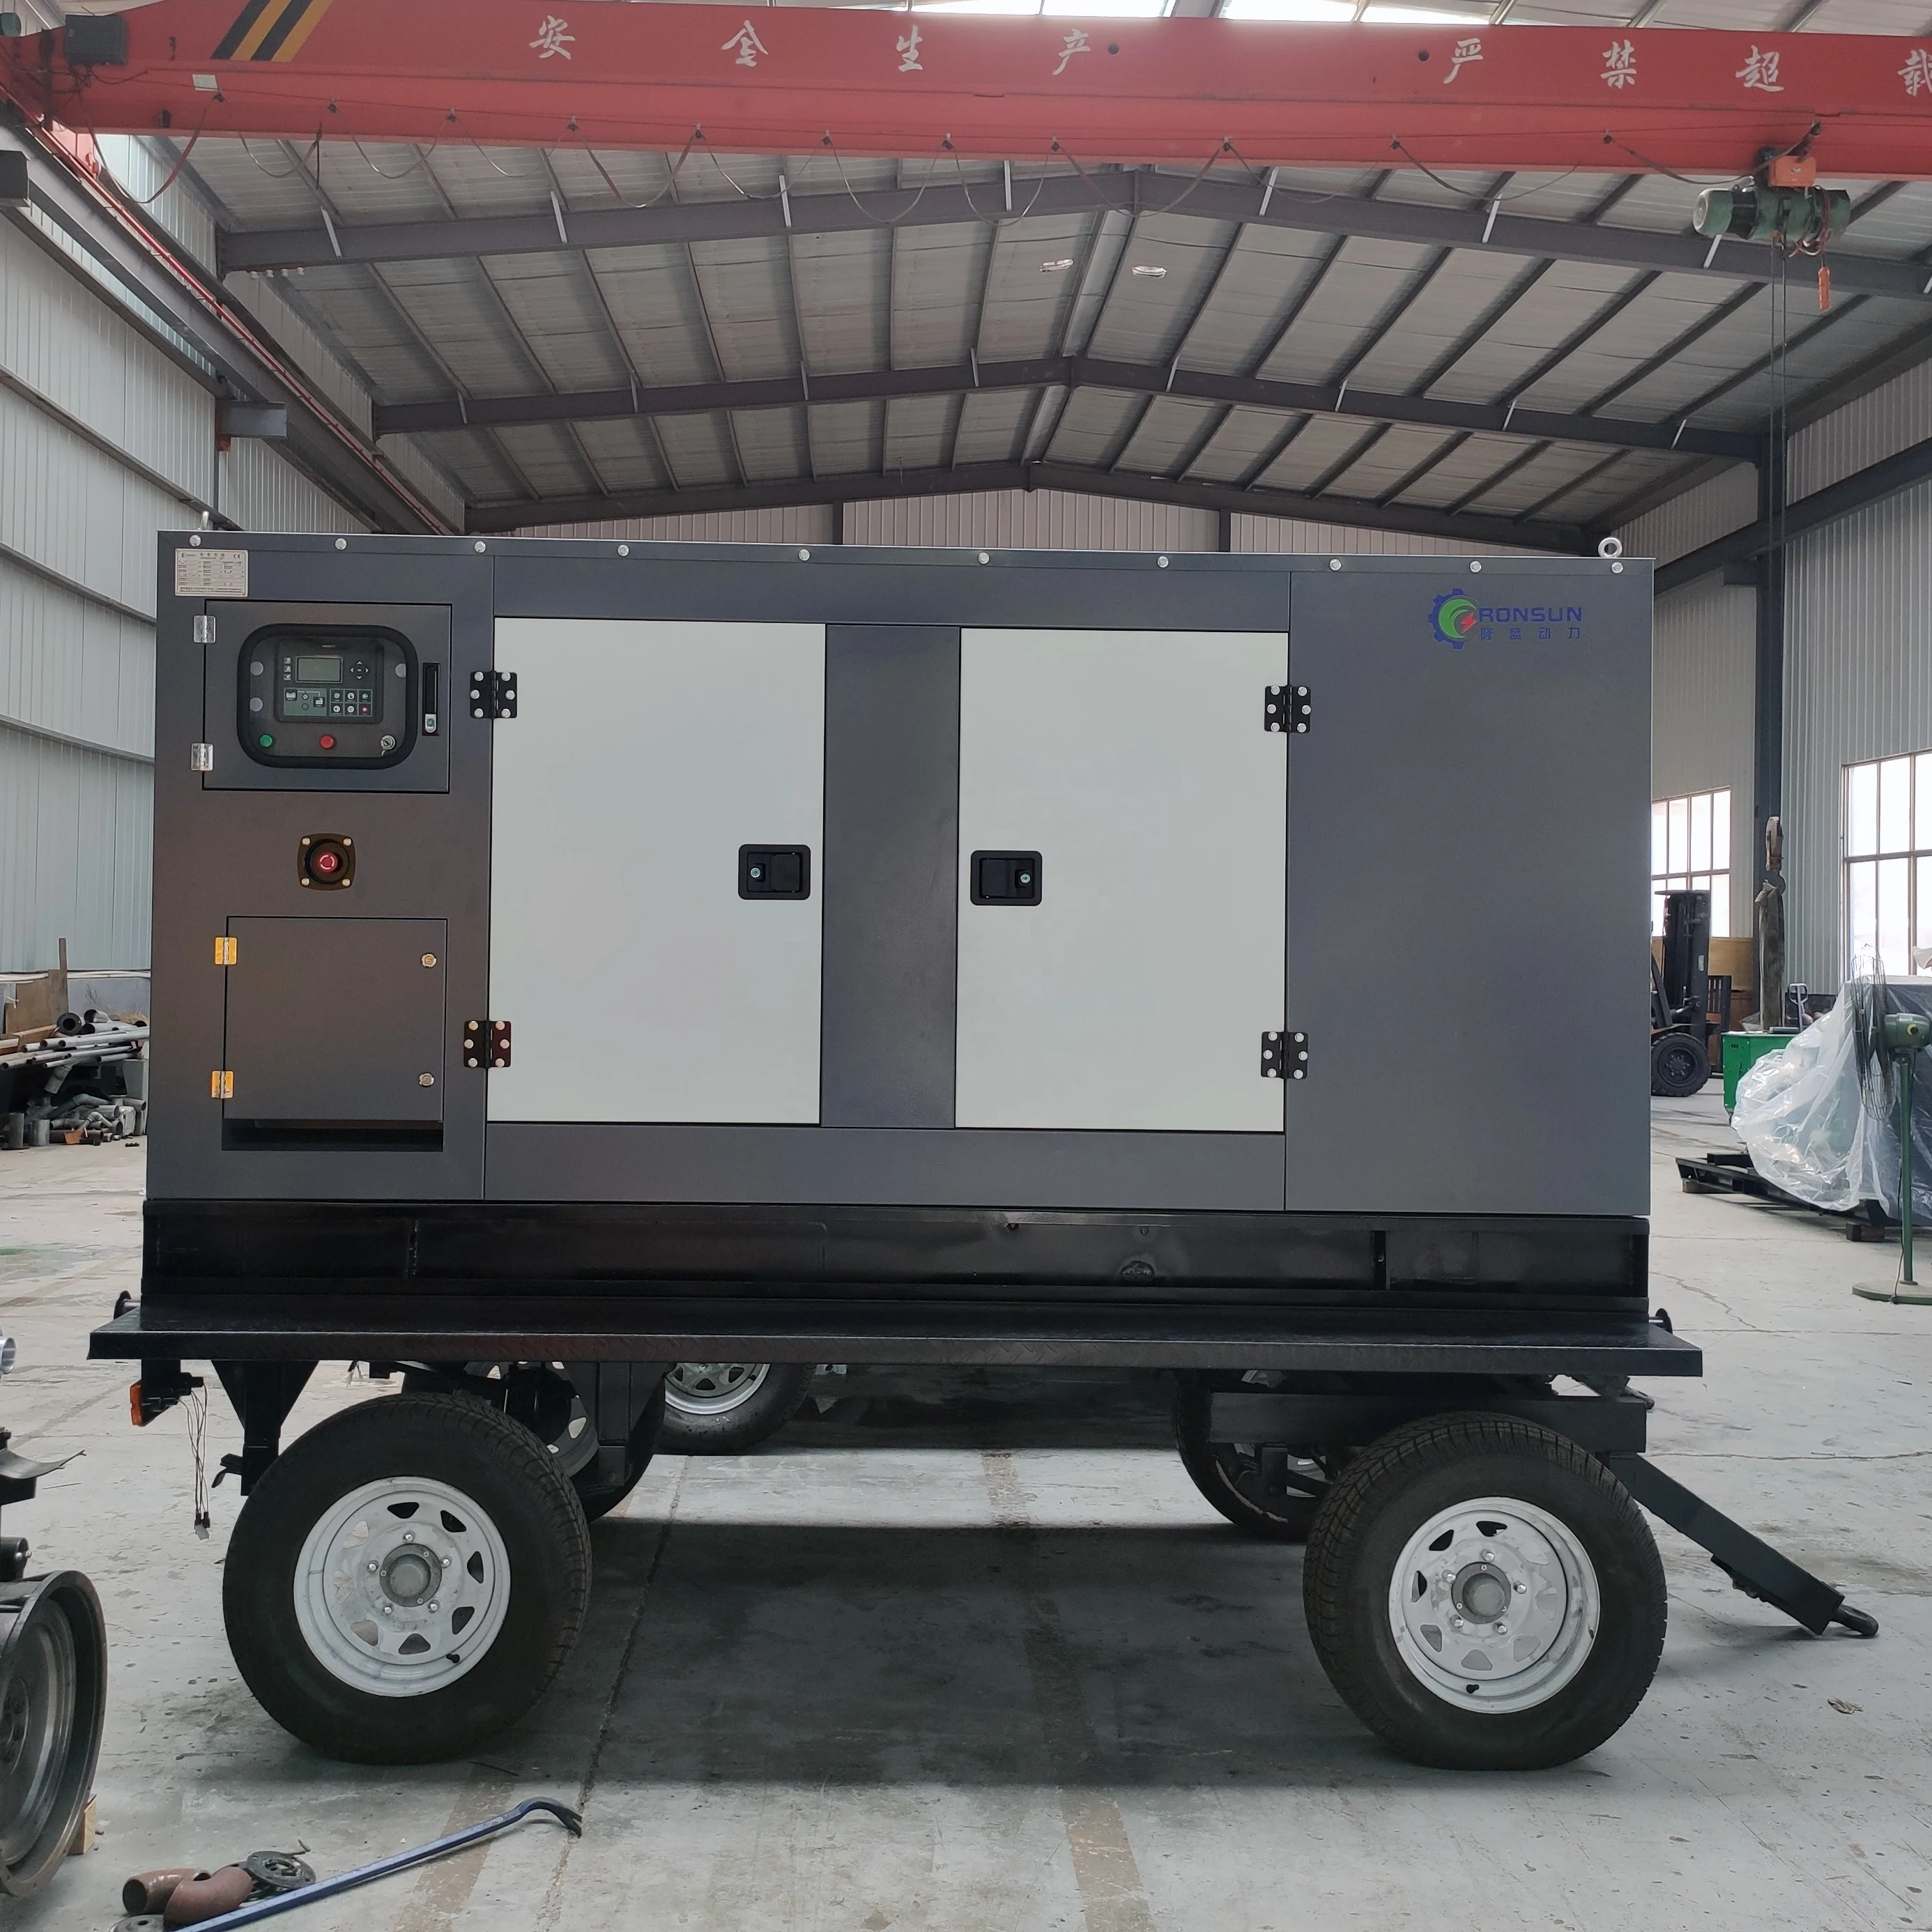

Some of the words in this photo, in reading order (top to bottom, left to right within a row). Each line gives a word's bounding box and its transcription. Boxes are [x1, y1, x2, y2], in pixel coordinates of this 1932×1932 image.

[529, 16, 1091, 76] 安全生产
[1478, 607, 1582, 622] RONSUN
[1480, 627, 1580, 640] 隆盛动力
